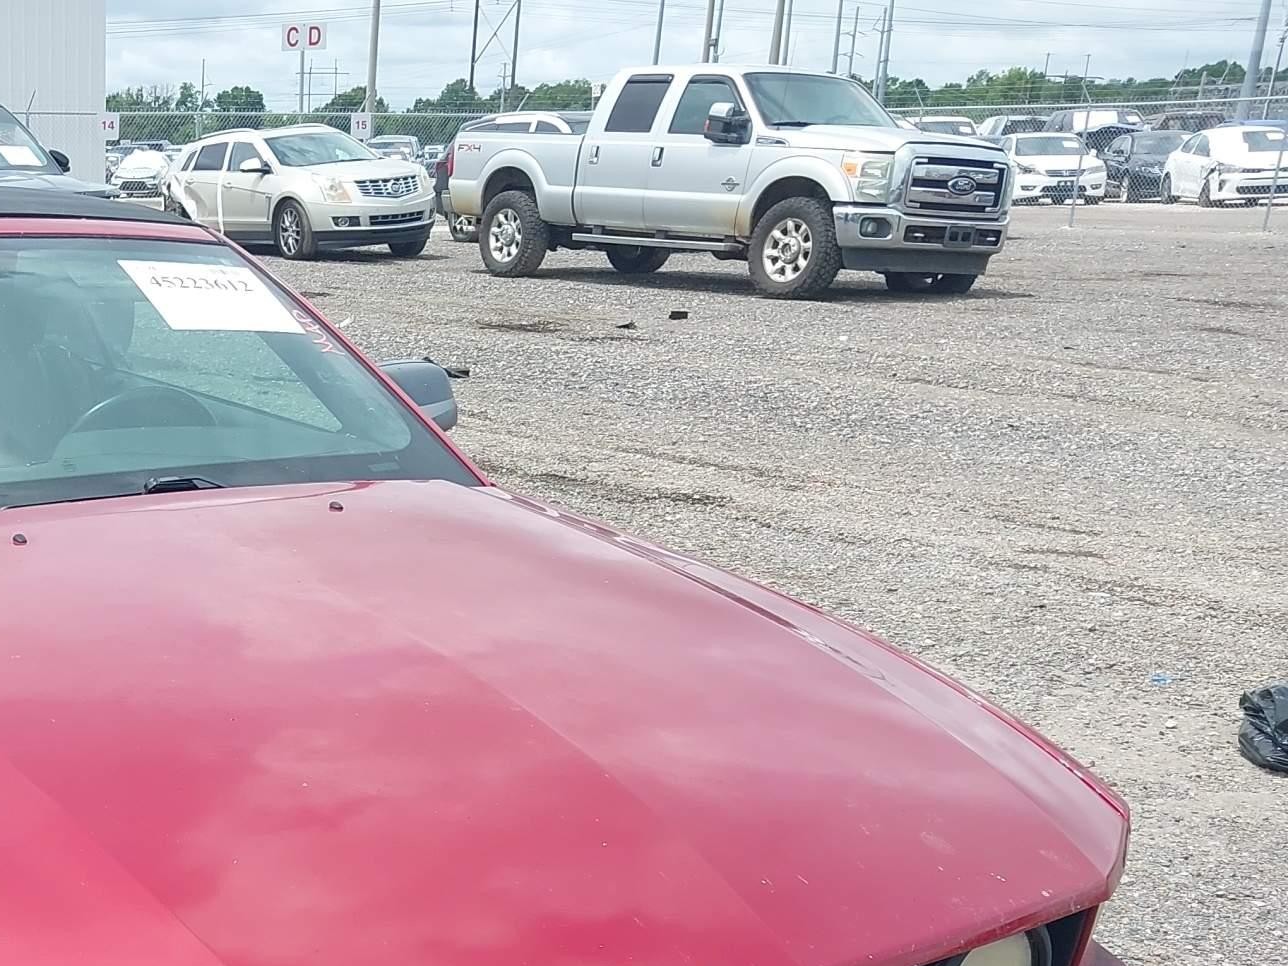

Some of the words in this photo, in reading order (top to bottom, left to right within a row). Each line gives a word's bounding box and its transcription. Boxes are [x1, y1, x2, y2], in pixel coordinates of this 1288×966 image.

[286, 26, 299, 48] C
[308, 26, 322, 46] D
[101, 120, 116, 131] 14
[355, 120, 368, 130] 15
[457, 143, 482, 152] FX4
[150, 275, 254, 293] 45223612
